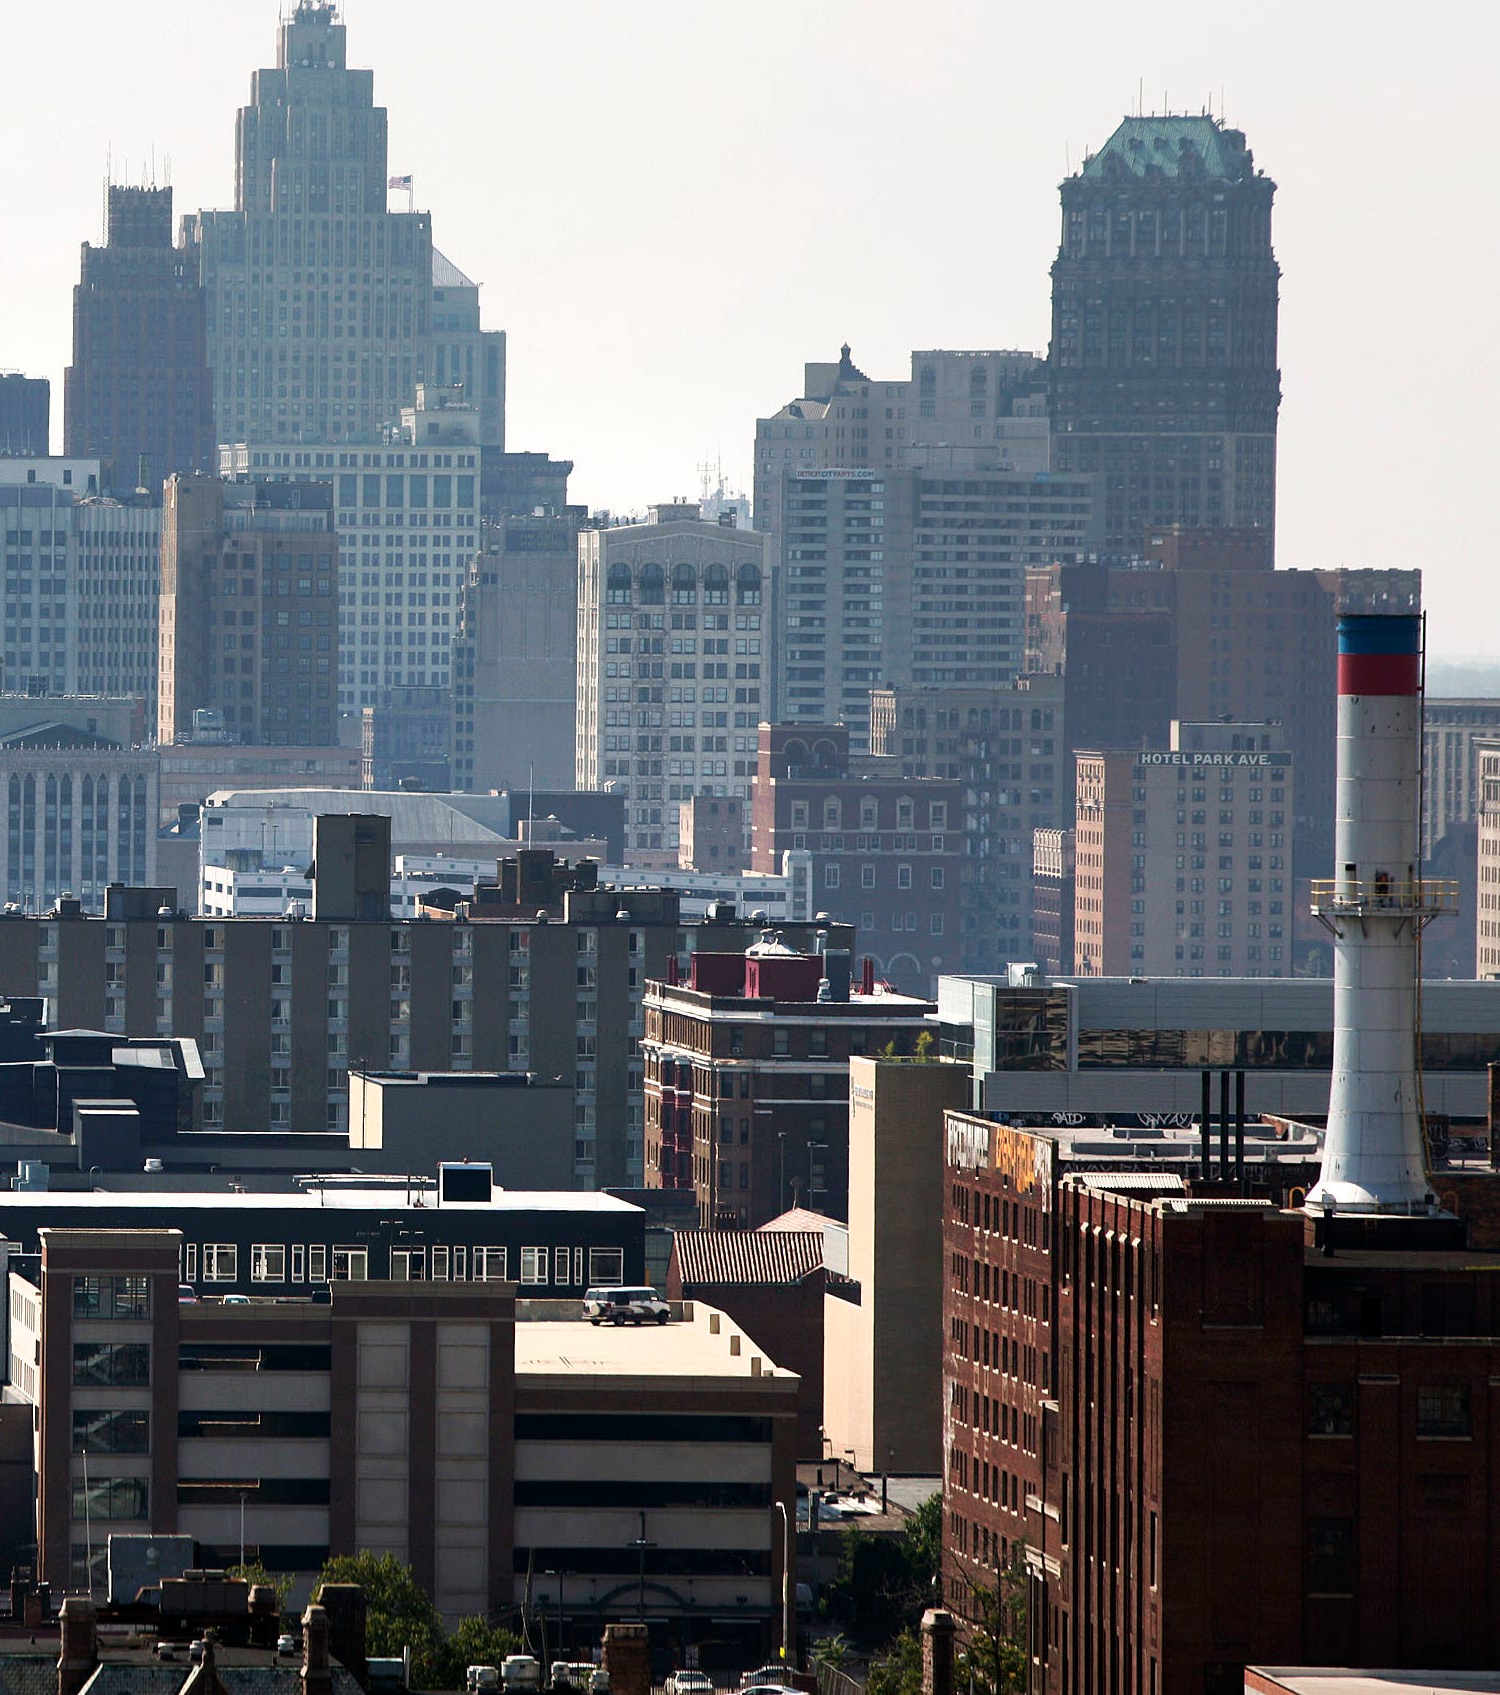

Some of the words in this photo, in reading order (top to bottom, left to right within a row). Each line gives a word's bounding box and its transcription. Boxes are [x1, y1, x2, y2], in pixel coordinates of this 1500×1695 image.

[1141, 753, 1190, 765] HOTEL
[1194, 754, 1234, 766] PARK
[1238, 754, 1272, 766] AVE.
